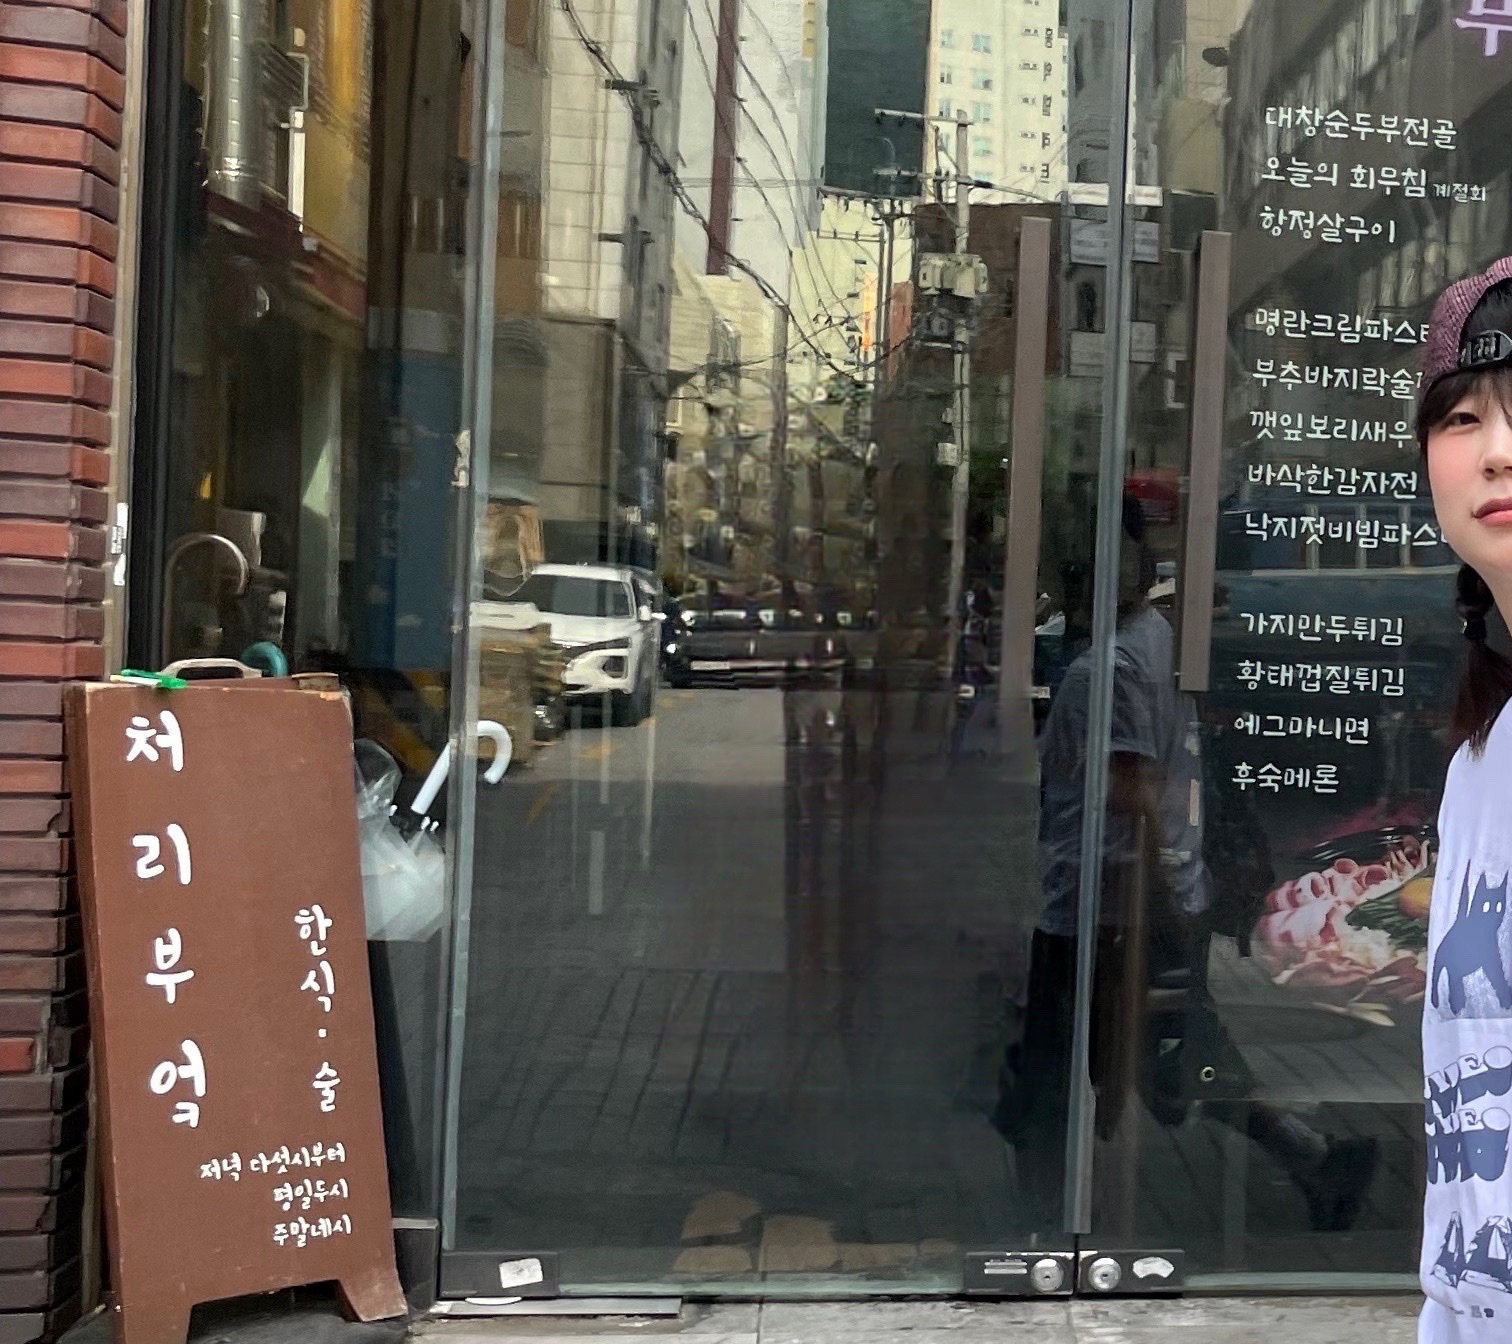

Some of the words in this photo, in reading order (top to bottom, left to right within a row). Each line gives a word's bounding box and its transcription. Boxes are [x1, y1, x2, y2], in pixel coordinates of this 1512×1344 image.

[1265, 105, 1458, 150] 대창순두부전골
[1260, 156, 1338, 189] 오늘의
[1350, 164, 1427, 200] 회무침
[1433, 183, 1486, 203] 계절회
[1259, 205, 1396, 244] 항정살구이
[1253, 358, 1423, 400] 부추바지락술
[1248, 463, 1418, 499] 바삭한감자전
[1245, 513, 1447, 549] 낙지젓비빔파스
[1239, 612, 1404, 646] 가지만두튀김
[1236, 659, 1405, 697] 황태껍질튀김
[1233, 714, 1370, 745] 에그마니면
[1231, 761, 1340, 794] 후숙메론
[200, 1152, 242, 1182] 저녁
[250, 1142, 346, 1174] 다섯시부터
[273, 1178, 349, 1212] 평일두시
[273, 1214, 352, 1248] 주말네시
